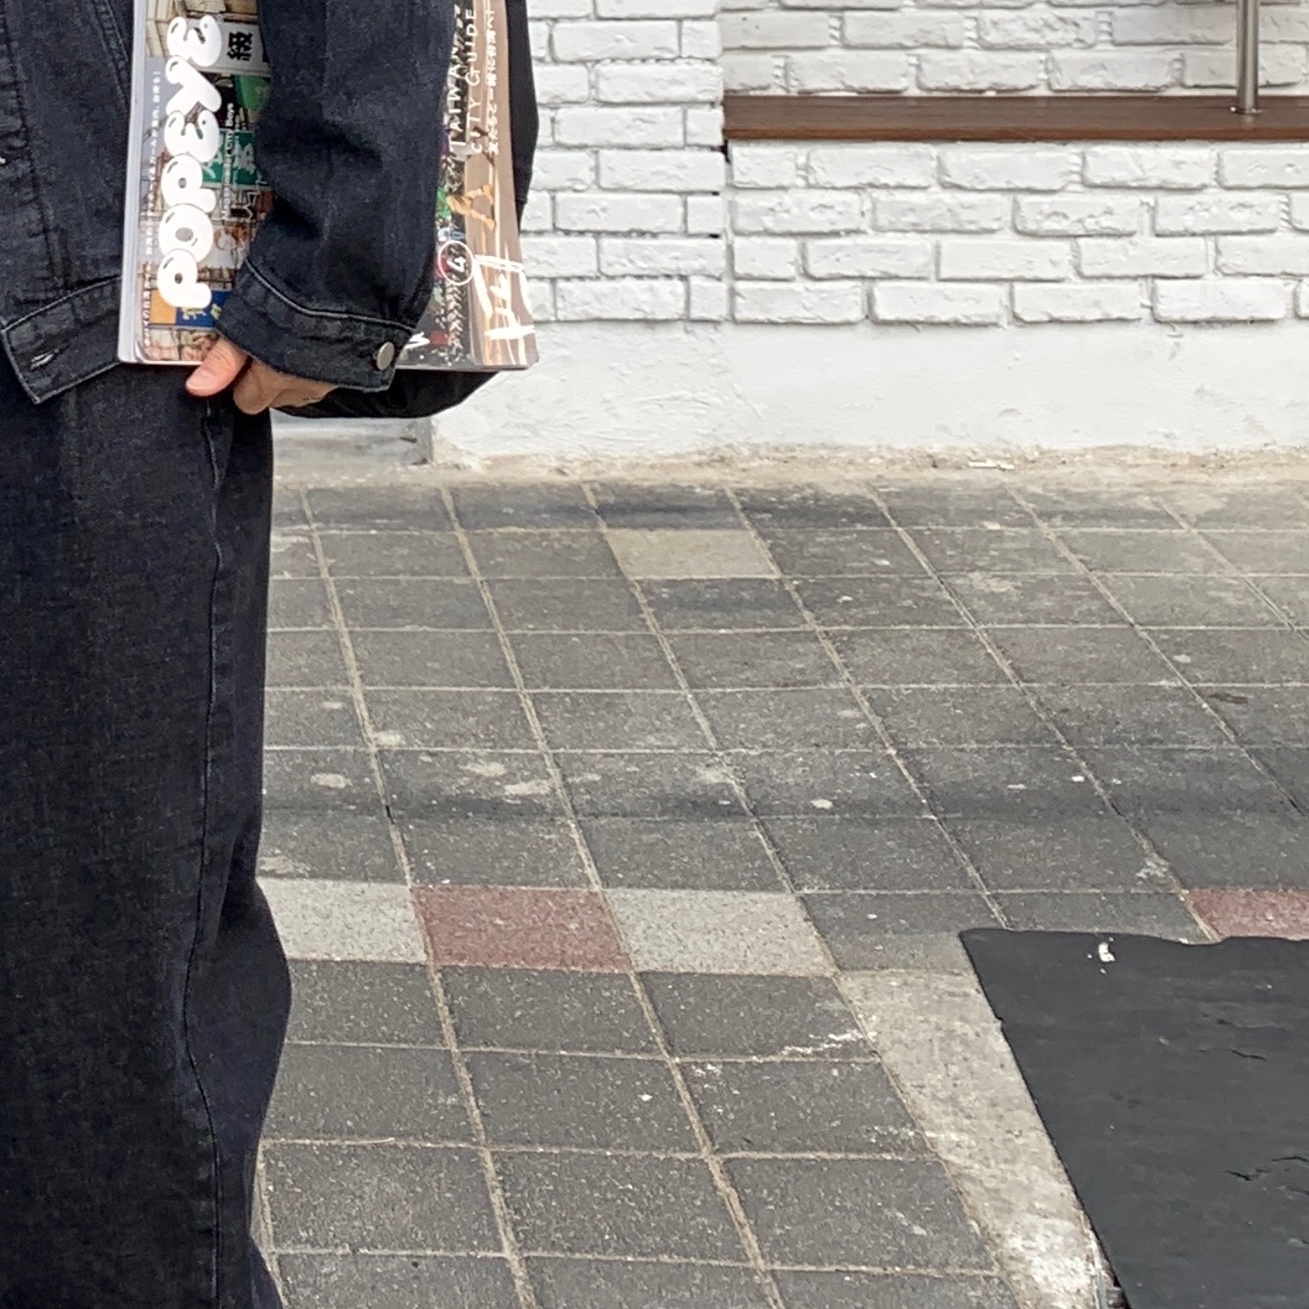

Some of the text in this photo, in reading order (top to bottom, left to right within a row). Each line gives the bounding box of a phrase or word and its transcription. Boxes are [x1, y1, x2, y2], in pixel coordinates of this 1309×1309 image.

[224, 102, 235, 127] Boys
[446, 46, 467, 153] TAIWAN
[464, 7, 483, 155] CITY GUIDE
